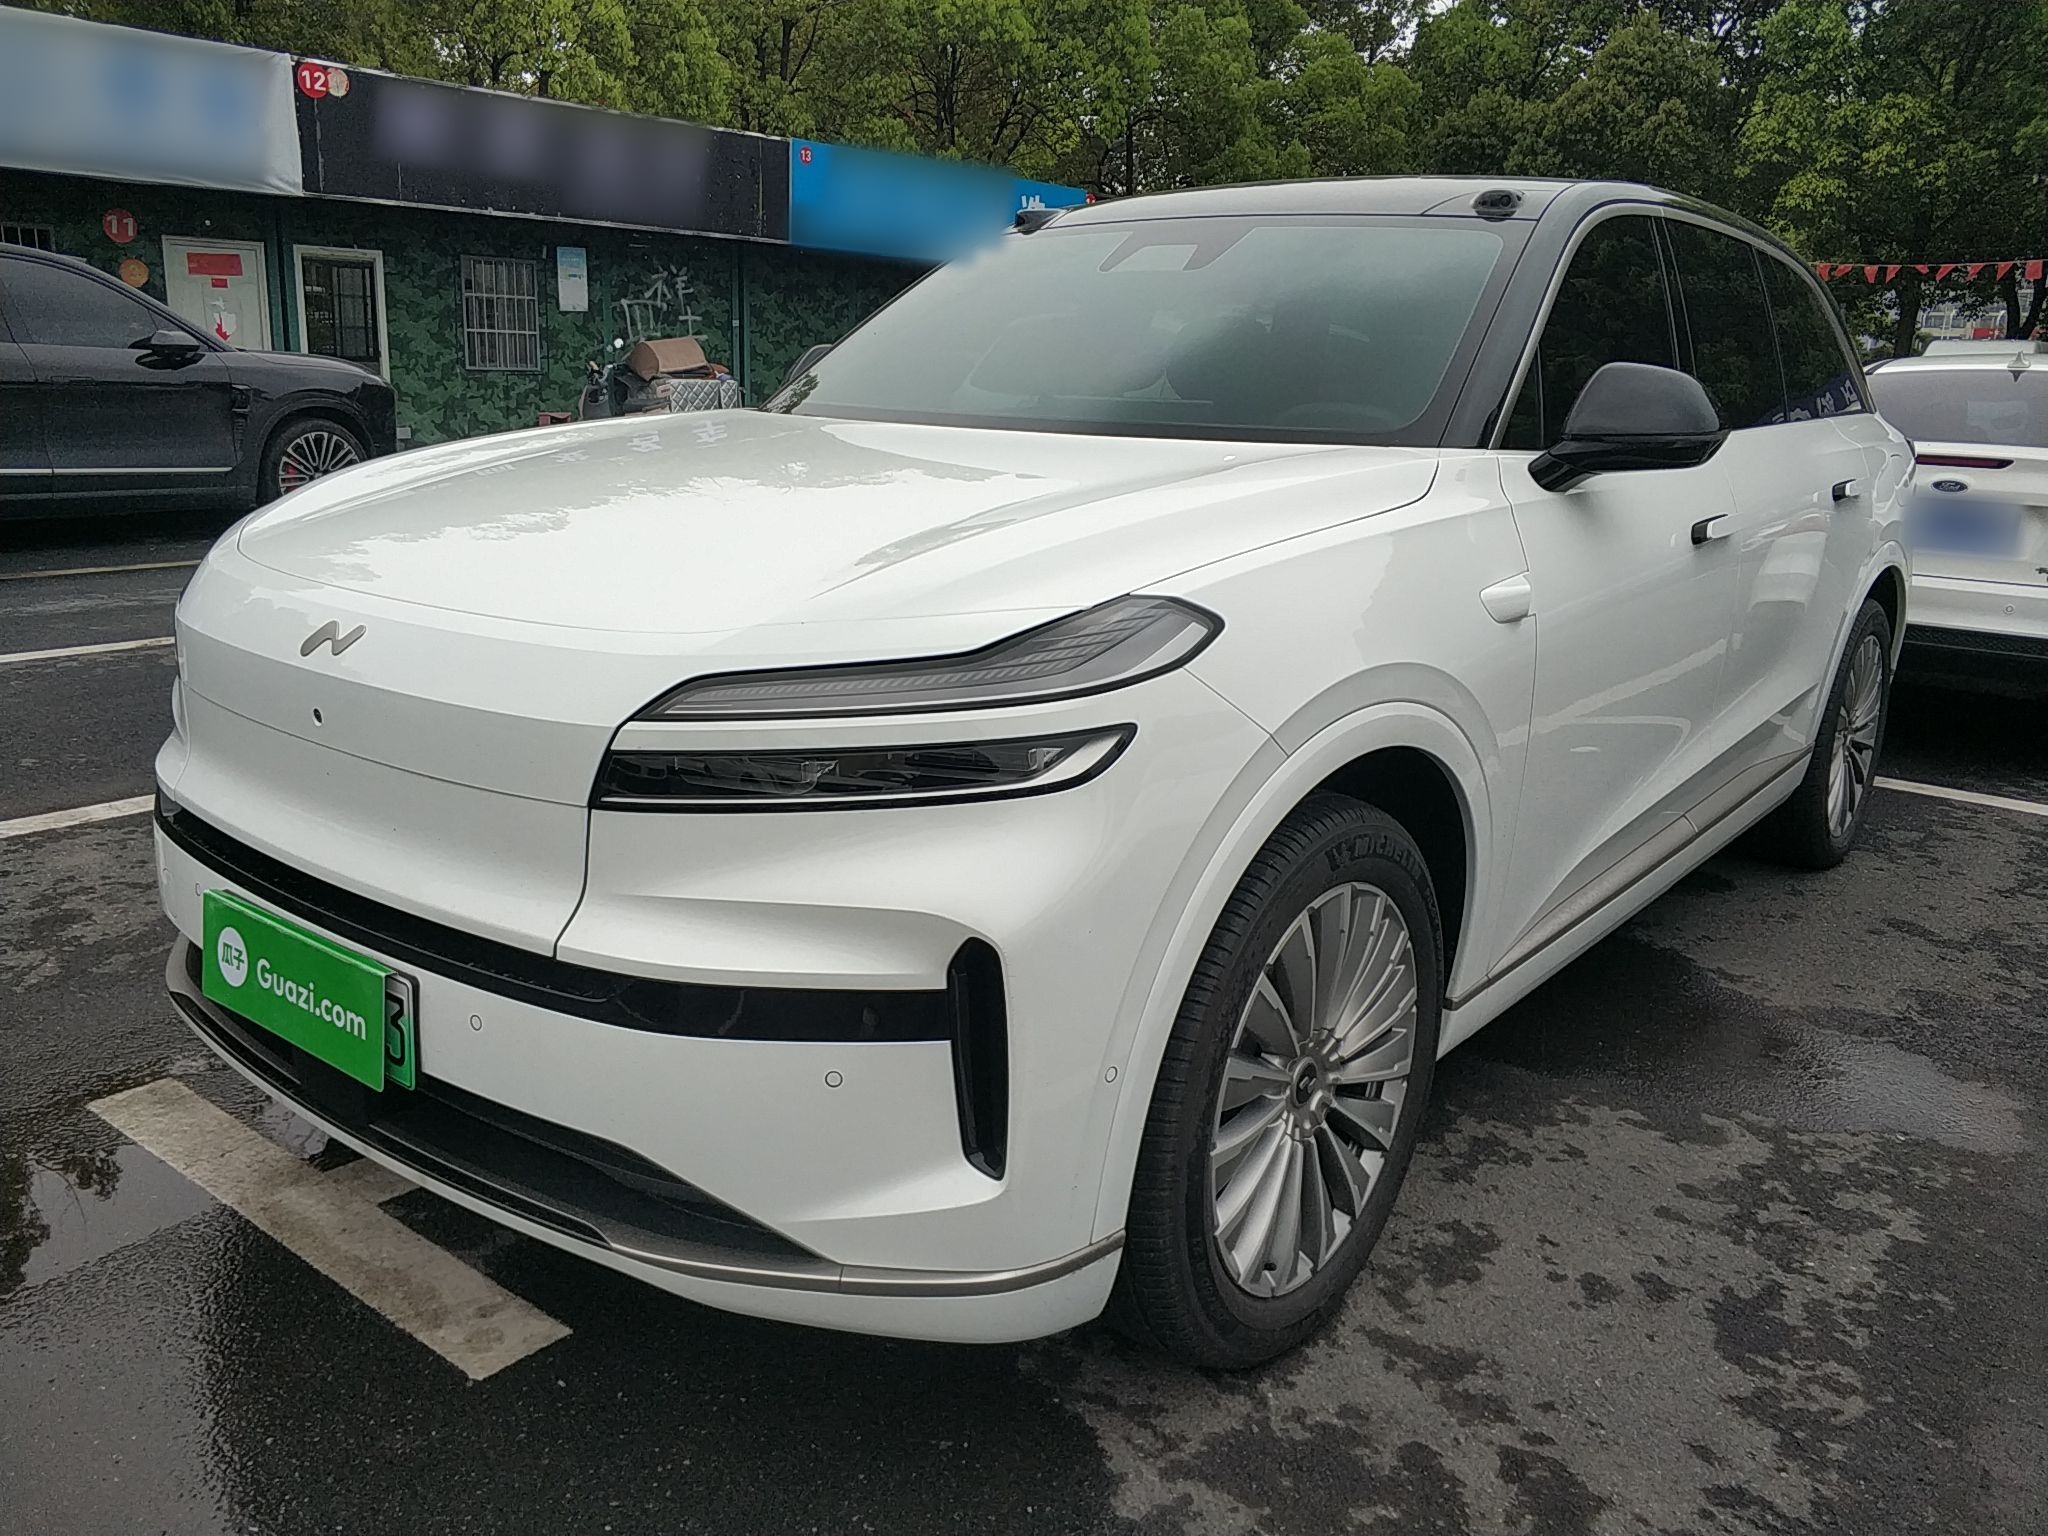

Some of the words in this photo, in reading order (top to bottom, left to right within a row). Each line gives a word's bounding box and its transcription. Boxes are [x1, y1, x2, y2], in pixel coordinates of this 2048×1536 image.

[302, 70, 327, 91] 12
[801, 150, 811, 162] 13
[106, 215, 134, 236] 11
[222, 942, 245, 970] 瓜子
[256, 958, 366, 1040] Guazi.com
